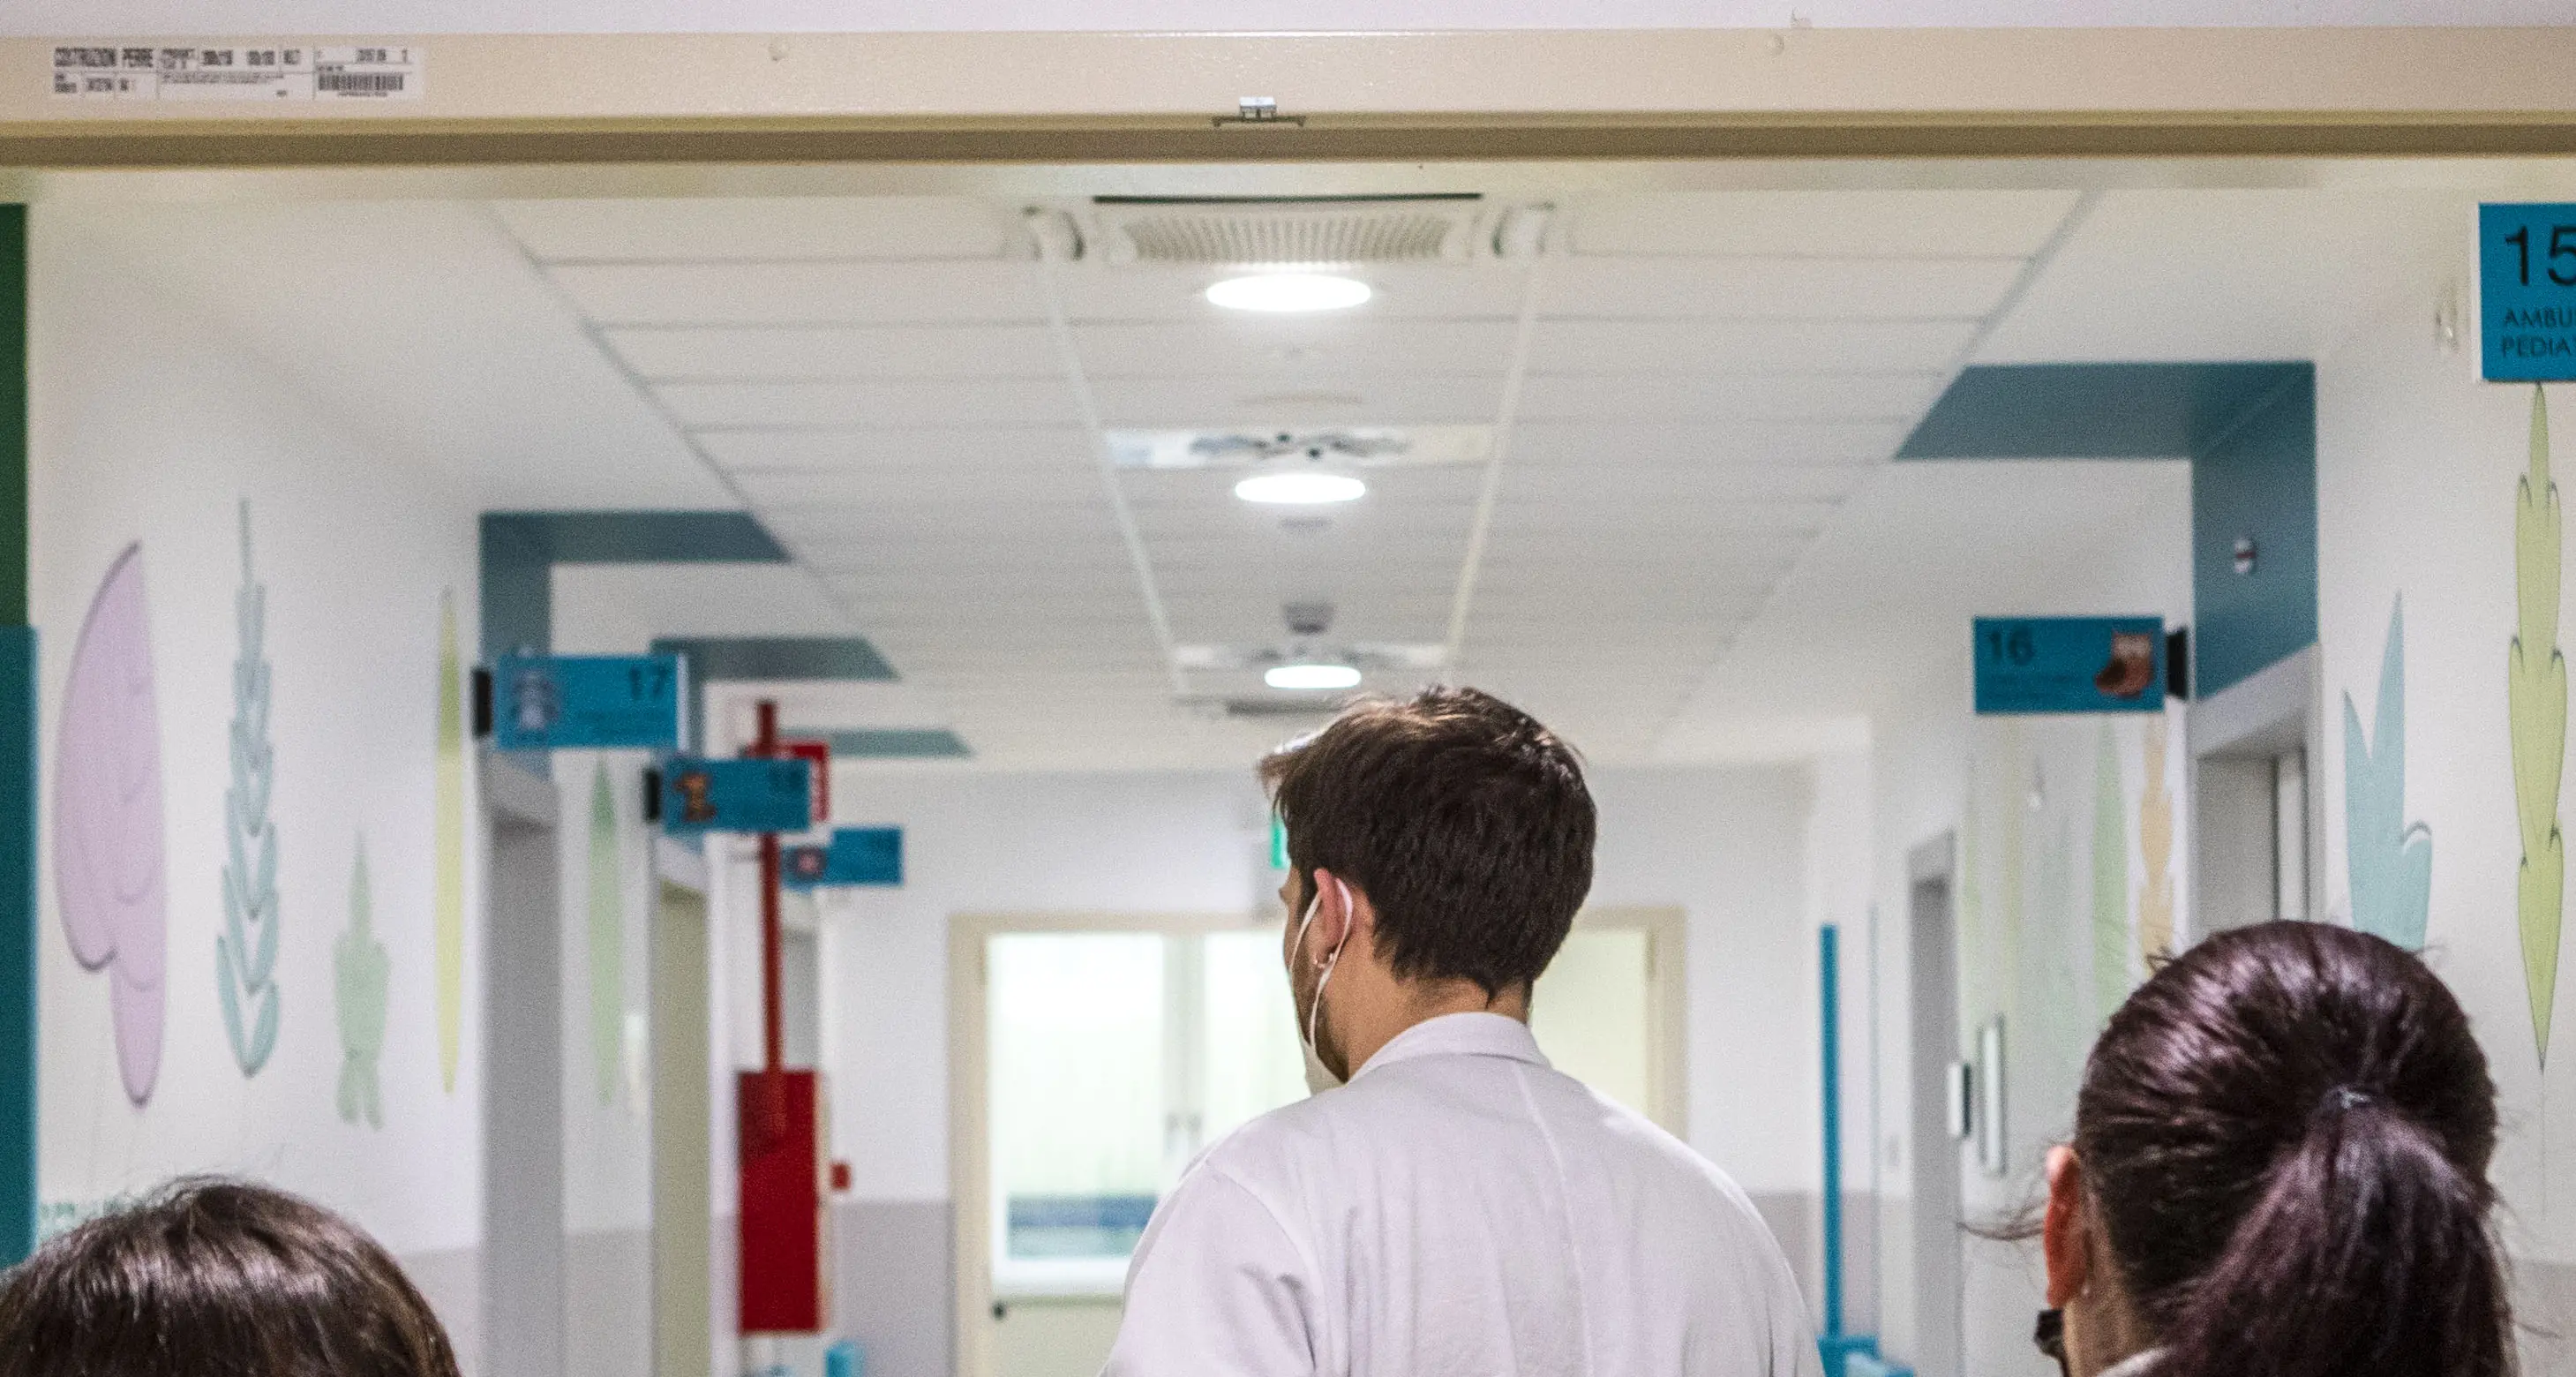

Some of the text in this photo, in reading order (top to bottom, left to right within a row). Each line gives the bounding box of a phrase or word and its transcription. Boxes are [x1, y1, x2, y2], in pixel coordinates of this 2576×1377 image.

[2504, 223, 2576, 287] 15
[2503, 306, 2576, 329] AMBU
[2500, 334, 2576, 357] PEDIA
[1988, 625, 2035, 666] 16
[627, 663, 671, 700] 17
